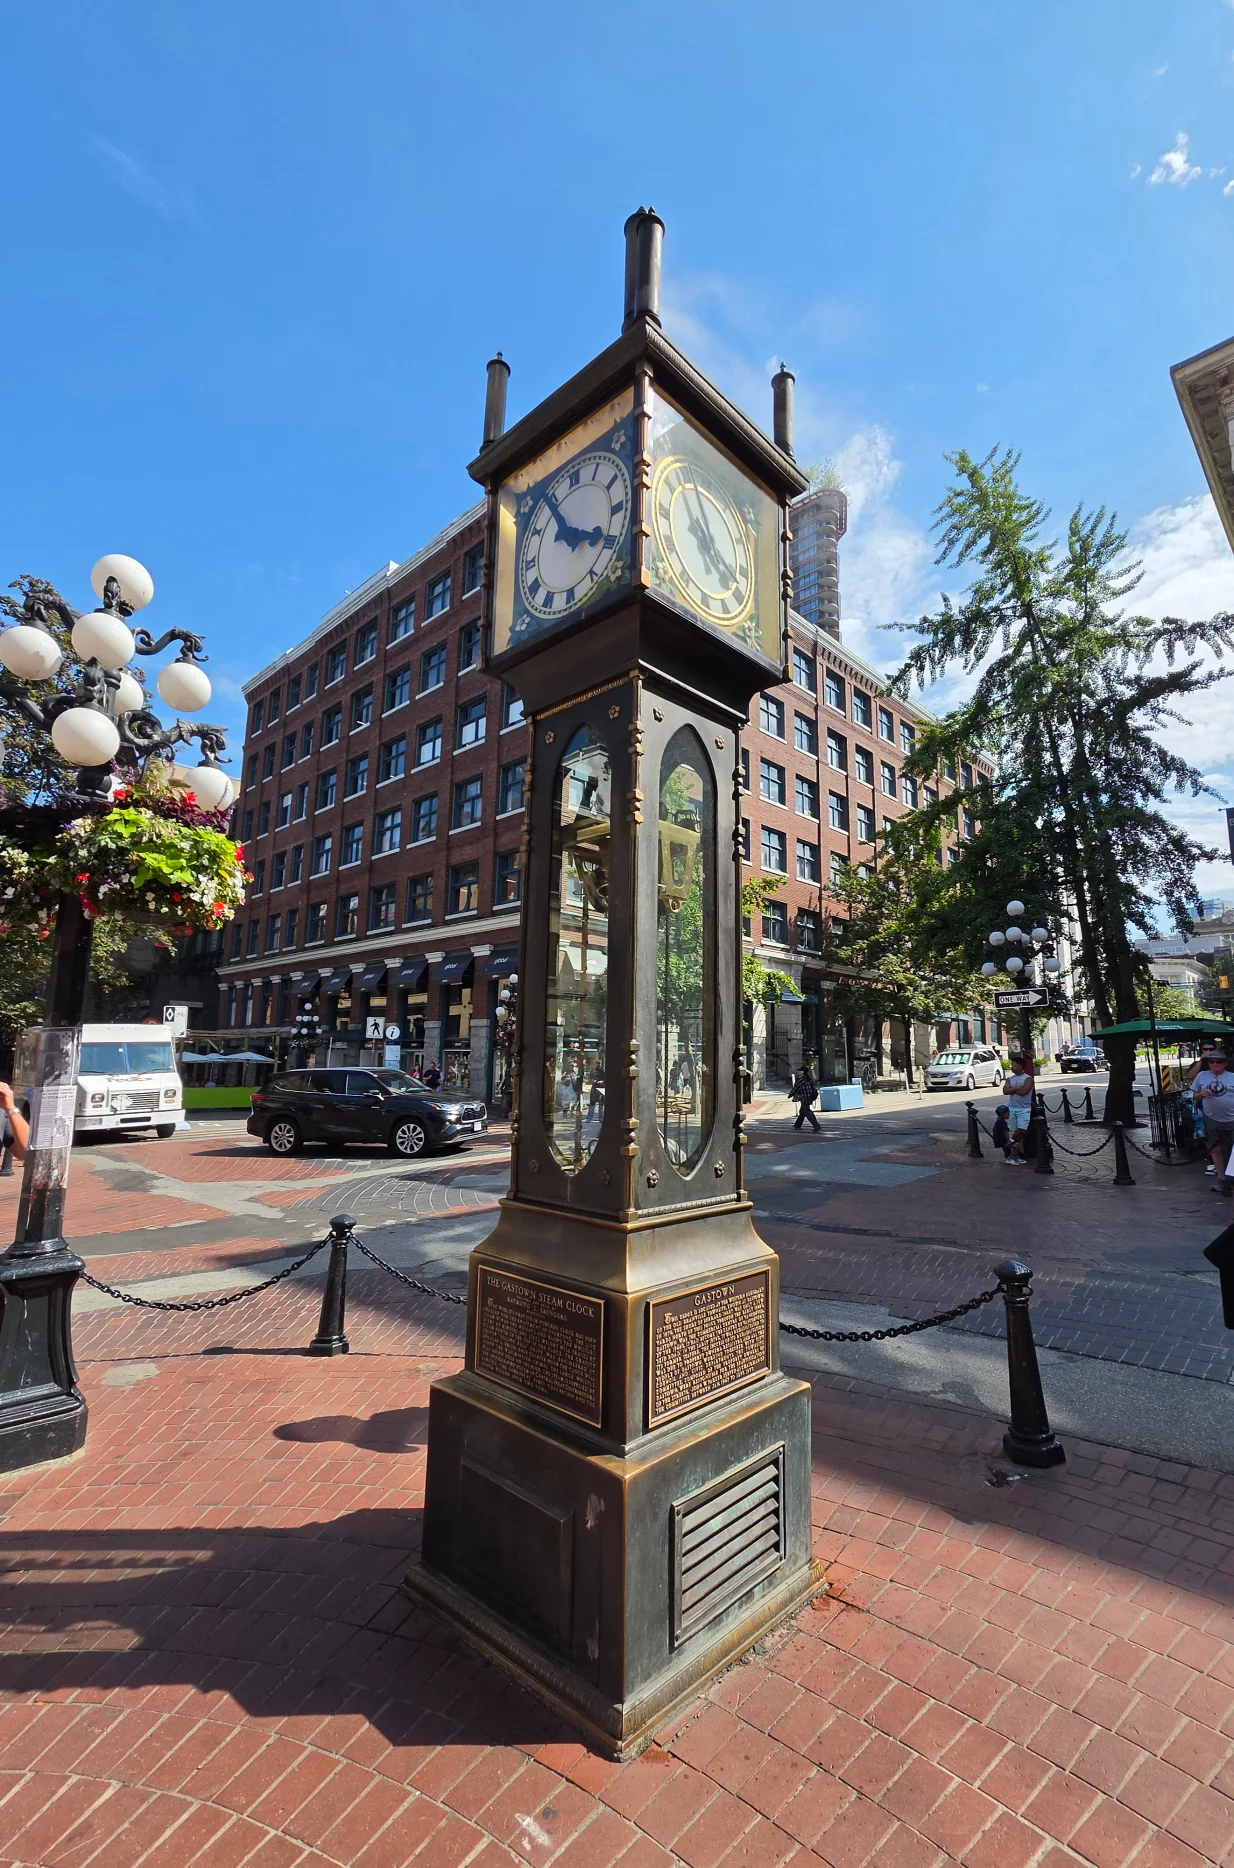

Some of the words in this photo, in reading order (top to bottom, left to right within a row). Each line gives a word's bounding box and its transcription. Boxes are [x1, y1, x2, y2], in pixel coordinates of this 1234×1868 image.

[487, 1276, 500, 1288] THE
[502, 1280, 536, 1299] GASTOWN
[539, 1292, 563, 1308] STEAM
[566, 1300, 594, 1318] CLOCK
[695, 1285, 734, 1306] GASTOWN
[508, 1297, 530, 1309] RAYMOND
[540, 1308, 567, 1321] SAUNDERS
